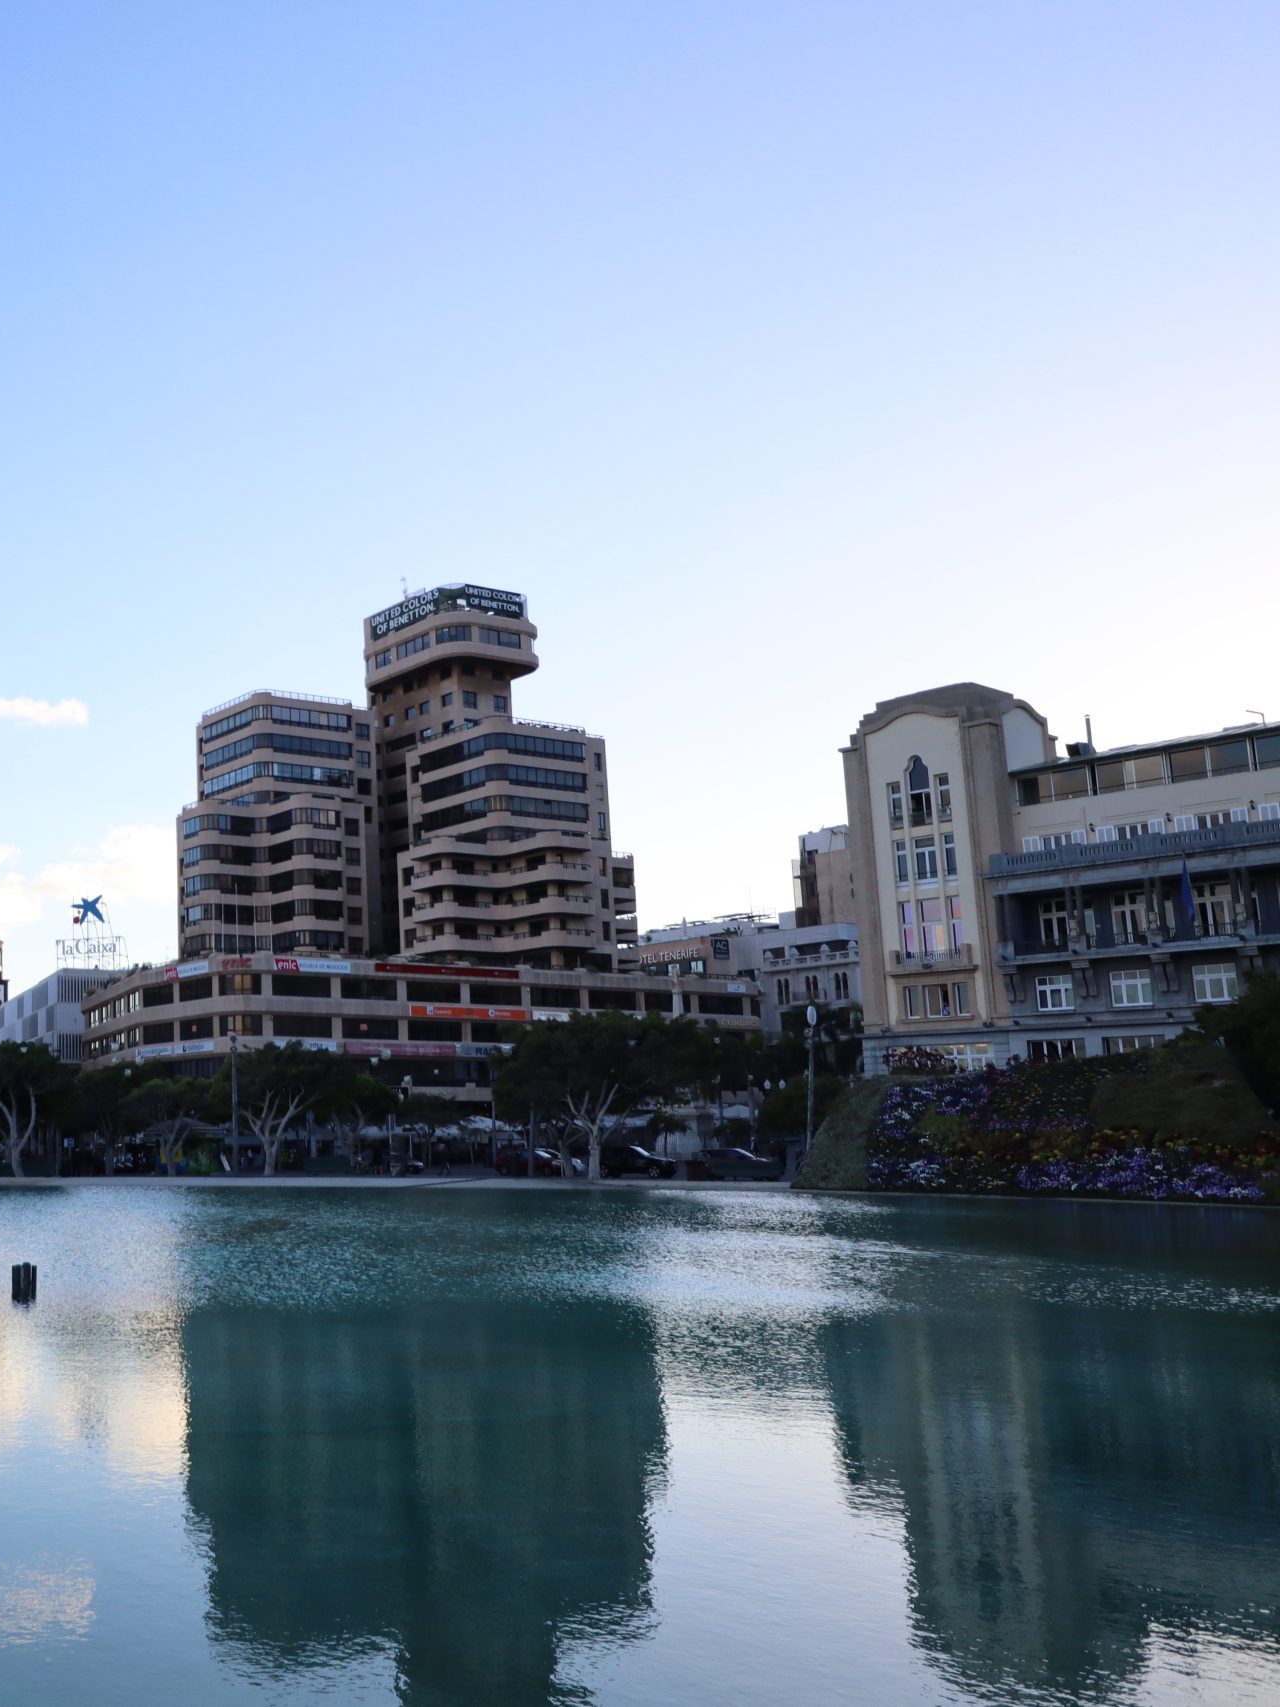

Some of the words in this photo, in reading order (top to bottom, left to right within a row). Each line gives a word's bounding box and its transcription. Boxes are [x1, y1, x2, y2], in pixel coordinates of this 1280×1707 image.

[465, 586, 491, 598] UNITED
[371, 606, 401, 627] UNITED
[402, 588, 439, 612] COLORS
[470, 597, 480, 606] OF
[376, 622, 388, 635] OF
[659, 948, 699, 962] TENERIFE
